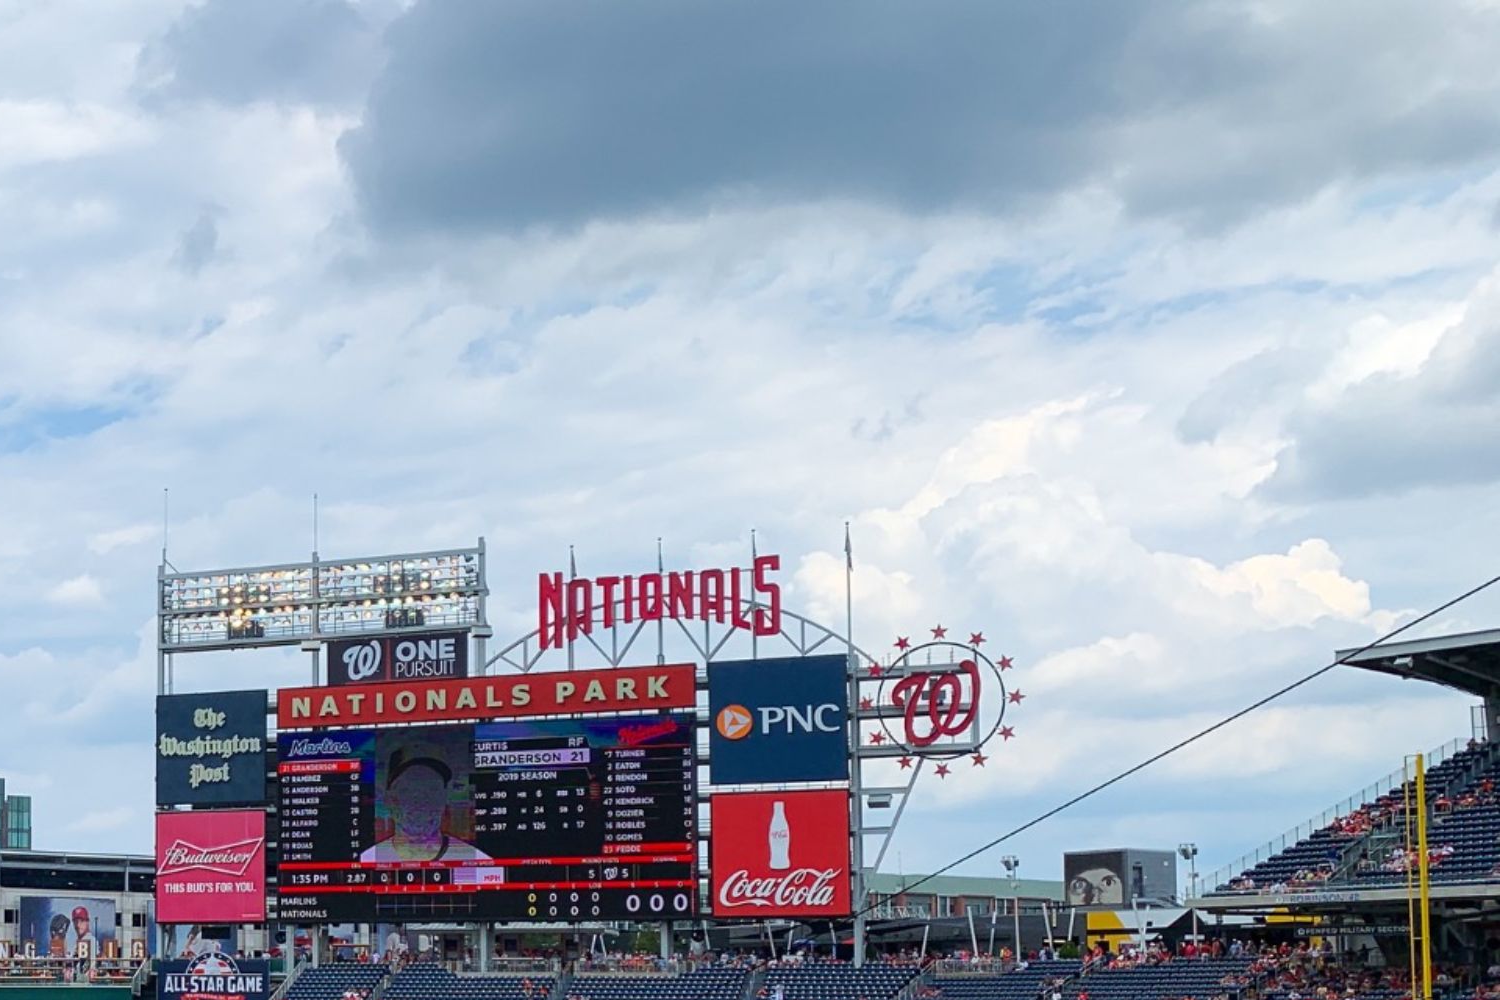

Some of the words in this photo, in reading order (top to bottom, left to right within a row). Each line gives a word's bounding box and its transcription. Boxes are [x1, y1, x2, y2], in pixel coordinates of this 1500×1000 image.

[539, 555, 780, 650] NATIONALS
[343, 640, 381, 680] W
[397, 638, 456, 659] ONE
[395, 658, 456, 677] PURSUIT
[291, 684, 531, 718] NATIONALS
[555, 675, 669, 704] PARK
[193, 708, 226, 730] The
[757, 703, 840, 734] PNC
[159, 733, 261, 758] Washington
[288, 737, 351, 756] Marlins
[568, 737, 584, 747] RF
[571, 752, 584, 761] 21
[189, 763, 230, 788] Post
[498, 773, 519, 781] 2019
[521, 771, 557, 780] SEASON
[166, 848, 250, 865] Budweiser
[292, 875, 311, 883] 1:35
[314, 874, 328, 883] PM
[588, 870, 595, 878] 5
[622, 869, 629, 878] 5
[164, 883, 185, 894] THIS
[187, 882, 213, 893] BUD'S
[215, 882, 233, 893] FOR
[235, 881, 257, 892] YOU.
[720, 868, 842, 908] Coca-Cola
[281, 897, 317, 905] MARLINS
[528, 893, 536, 902] 0
[549, 893, 557, 902] 0
[570, 893, 579, 902] 0
[592, 892, 599, 902] 0
[626, 895, 640, 912] 0
[650, 894, 664, 911] 0
[673, 894, 688, 911] 0
[281, 910, 327, 918] NATIONALS
[528, 906, 536, 916] 0
[549, 906, 557, 916] 0
[570, 906, 579, 916] 0
[592, 906, 599, 915] 0
[227, 975, 263, 992] GAME
